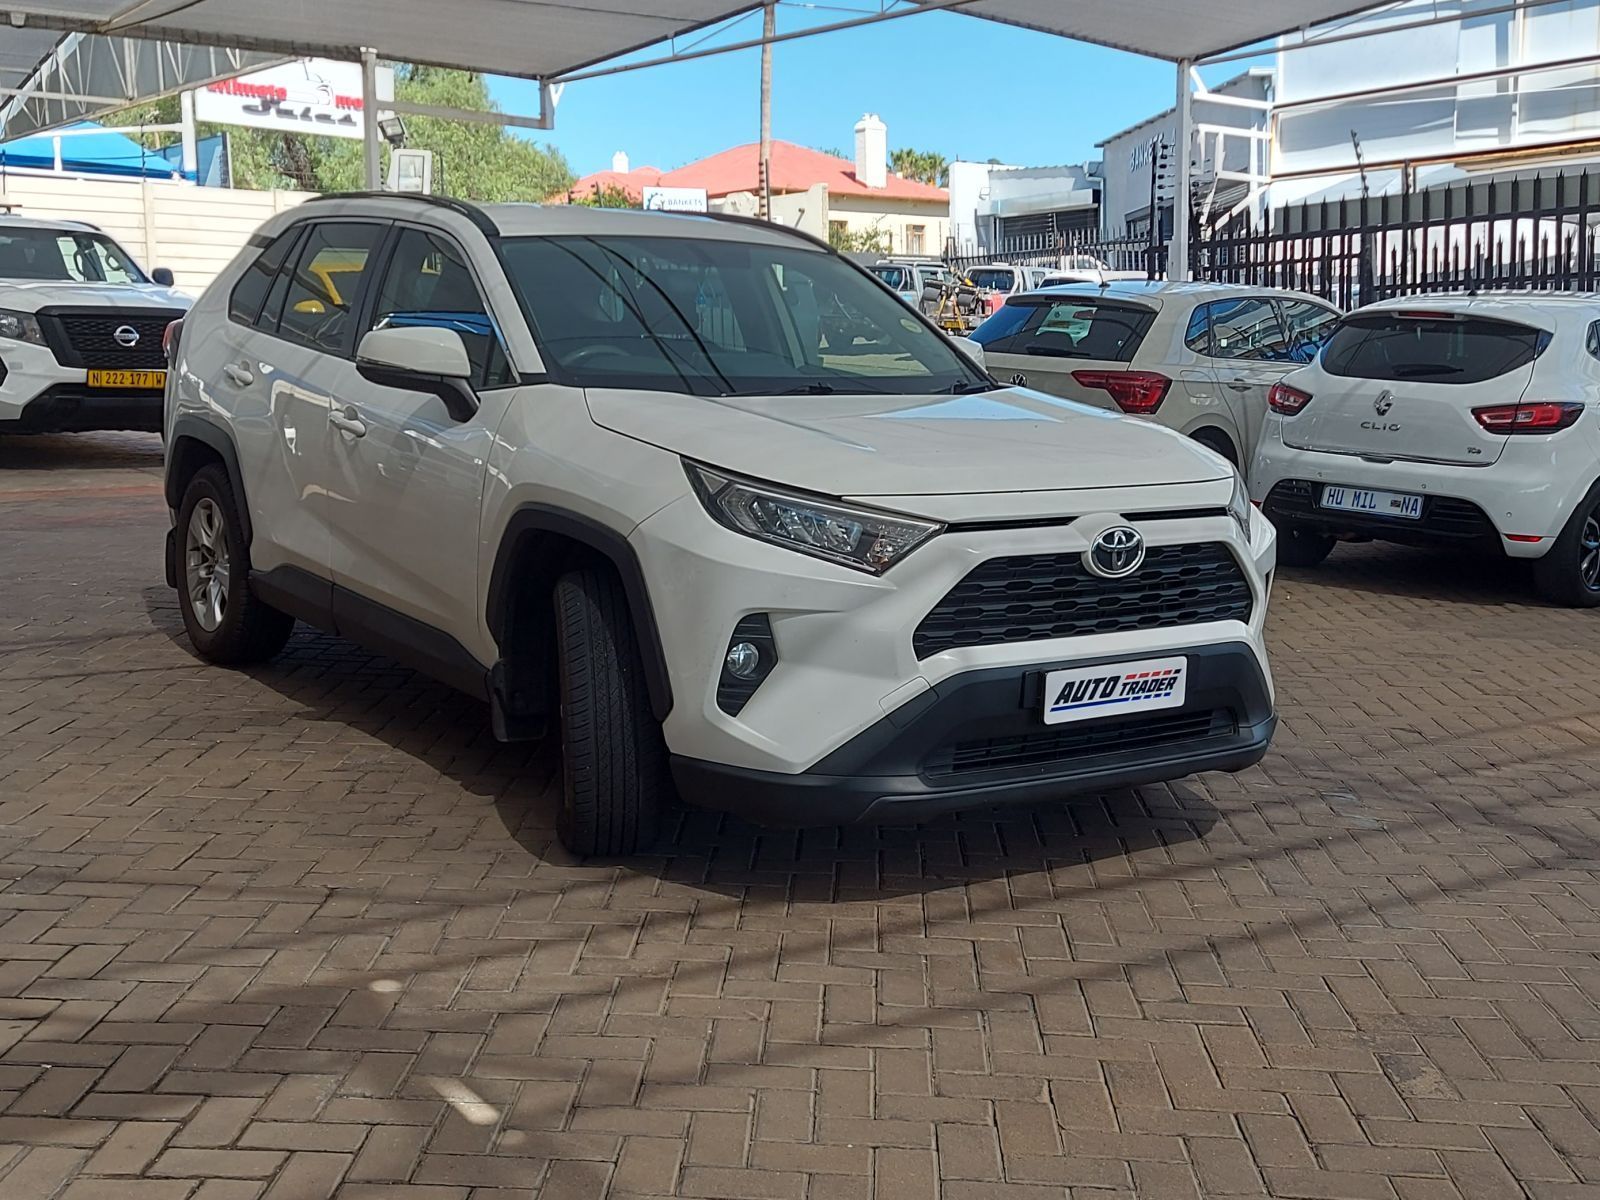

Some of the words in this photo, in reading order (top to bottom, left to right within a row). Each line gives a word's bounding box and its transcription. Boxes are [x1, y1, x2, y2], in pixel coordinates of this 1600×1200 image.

[93, 373, 99, 384] N
[1360, 421, 1401, 432] CLIO
[1326, 488, 1345, 506] HU
[1351, 490, 1377, 510] MIL
[1400, 496, 1420, 516] NA
[1053, 675, 1121, 706] AUTO
[1119, 676, 1178, 697] TRADER
